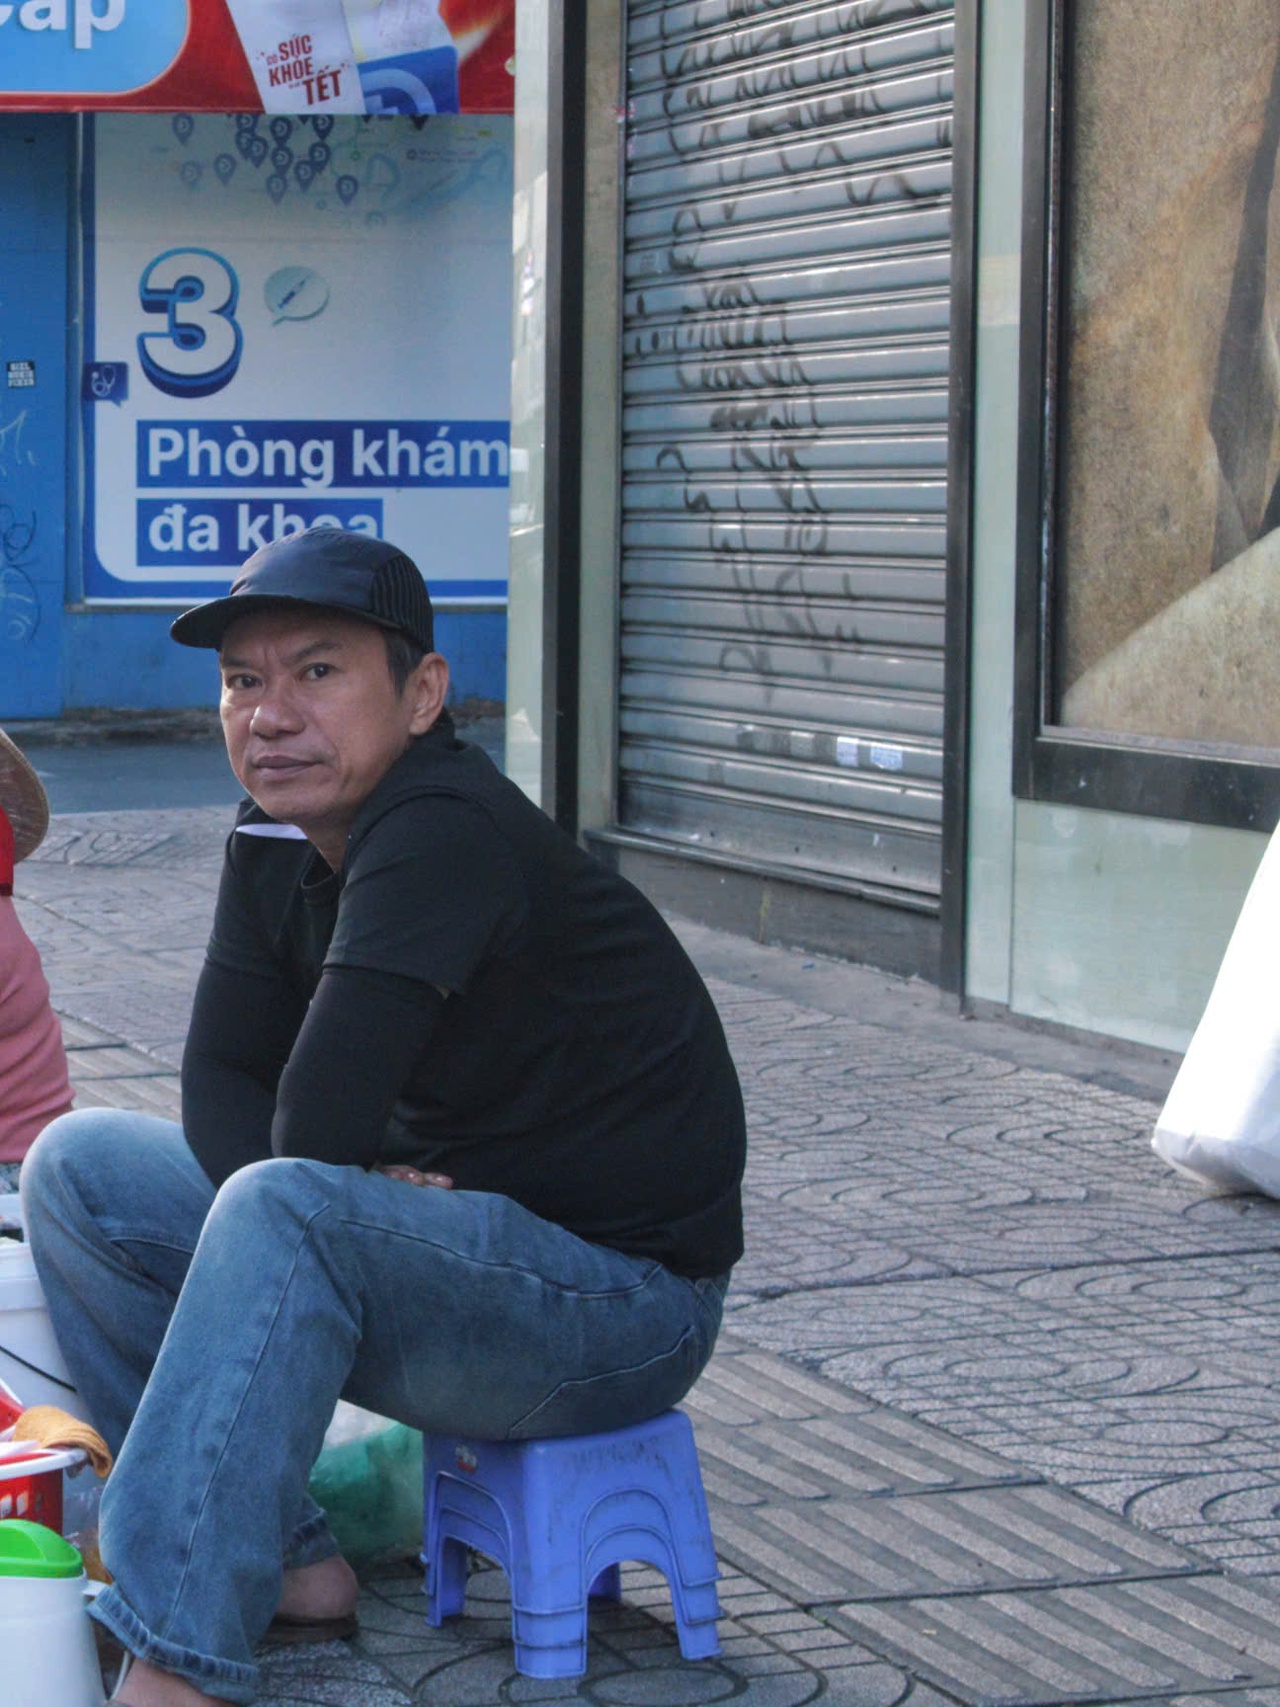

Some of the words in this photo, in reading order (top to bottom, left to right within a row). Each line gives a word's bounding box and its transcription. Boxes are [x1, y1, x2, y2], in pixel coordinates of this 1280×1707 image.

[137, 246, 244, 399] 3
[148, 425, 335, 488] Phòng
[352, 426, 509, 478] khám
[148, 503, 219, 551] đa
